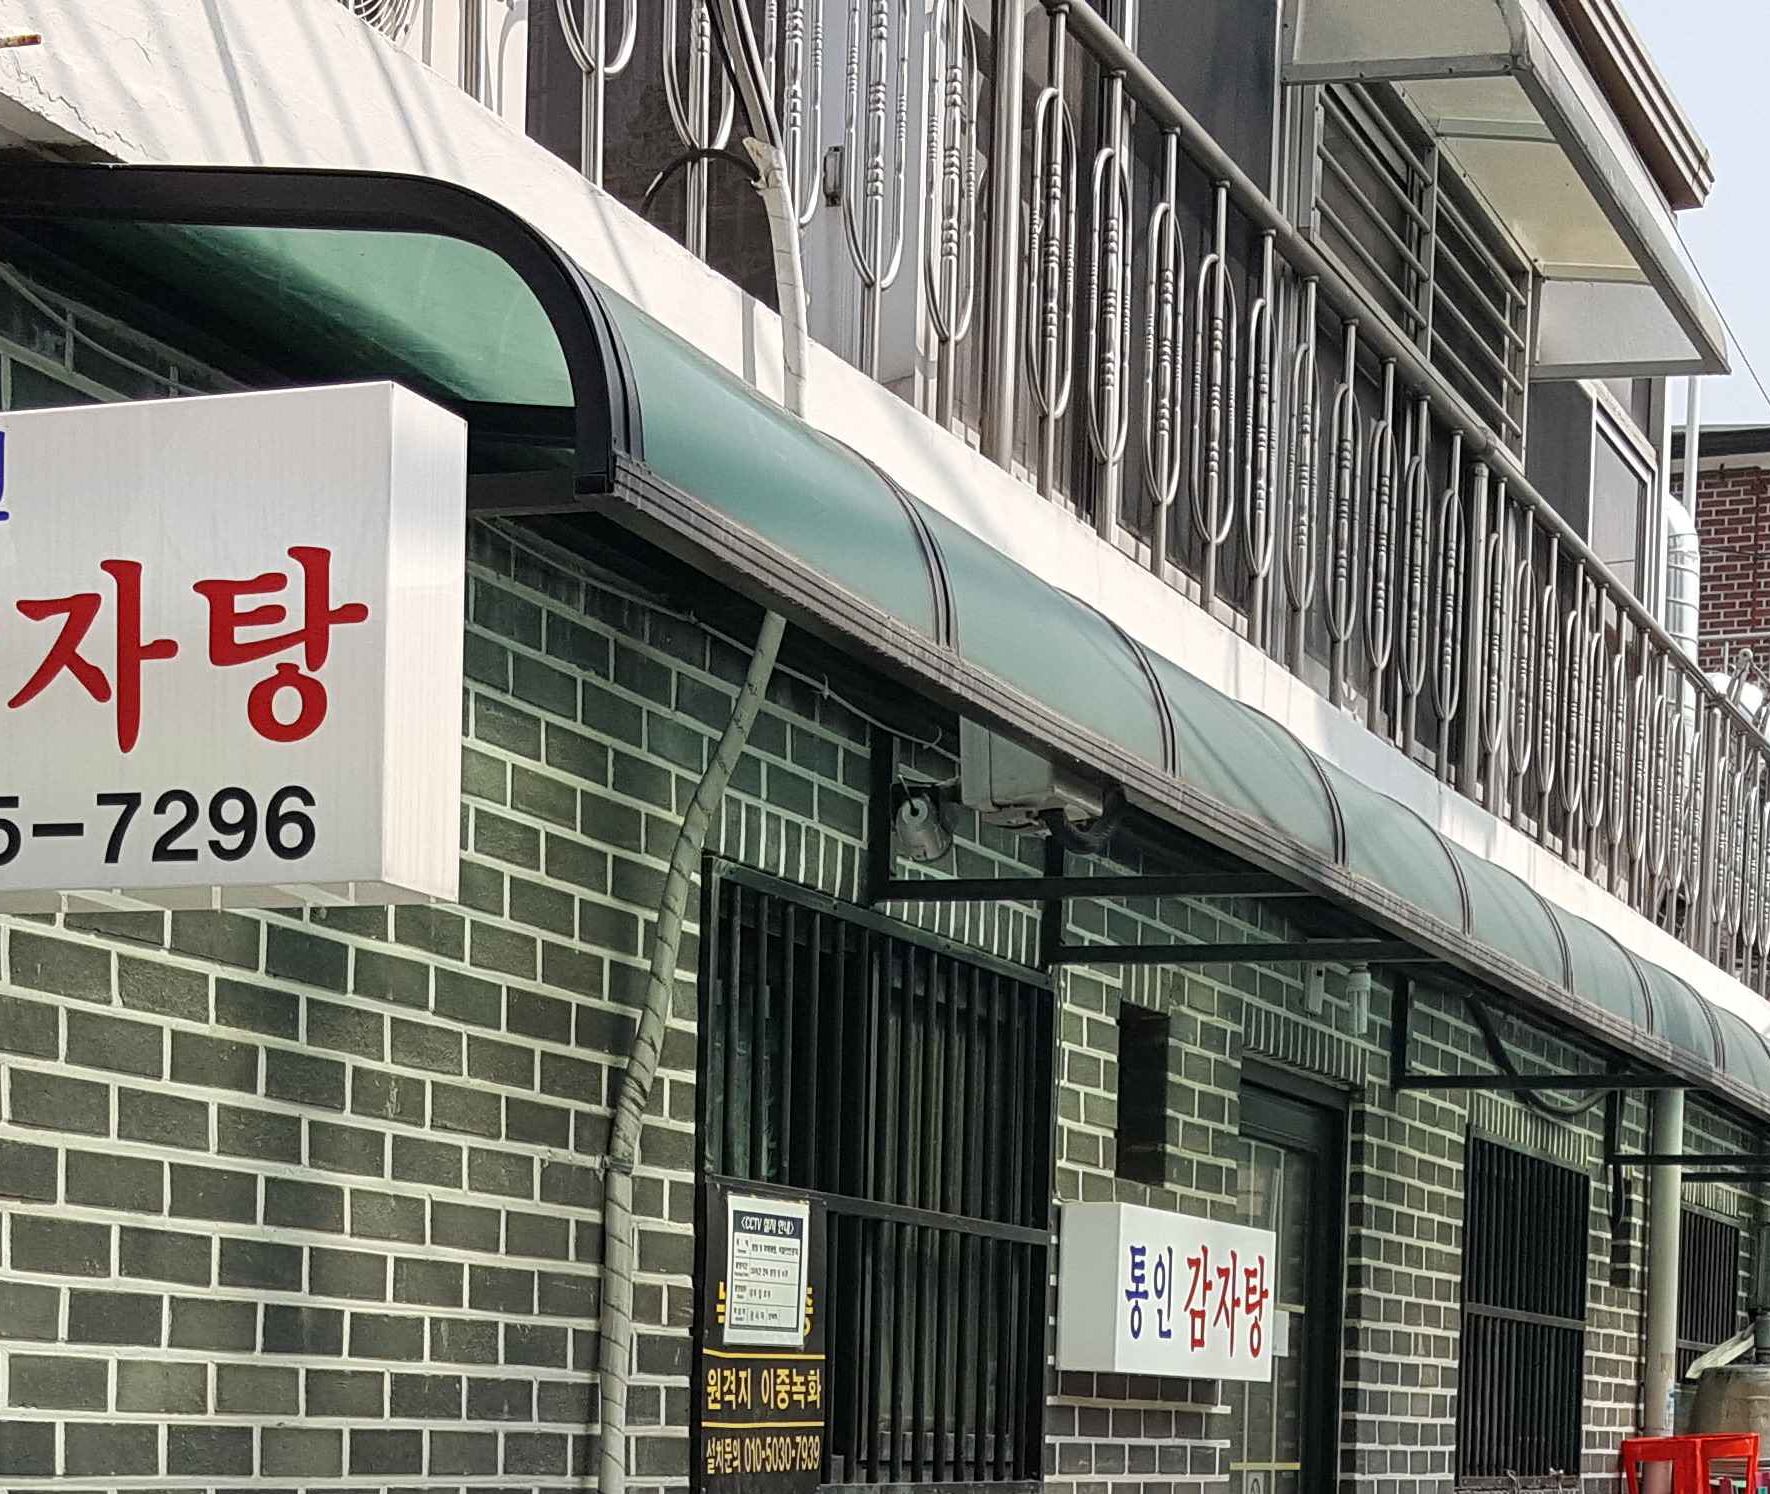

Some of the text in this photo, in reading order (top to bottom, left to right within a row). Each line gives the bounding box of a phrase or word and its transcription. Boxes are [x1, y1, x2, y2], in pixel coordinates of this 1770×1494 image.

[1125, 1244, 1269, 1358] 통인 감자탕
[707, 1368, 821, 1409] 원격지 이중녹화
[707, 1435, 820, 1474] 설치문의 010-5030-7939
